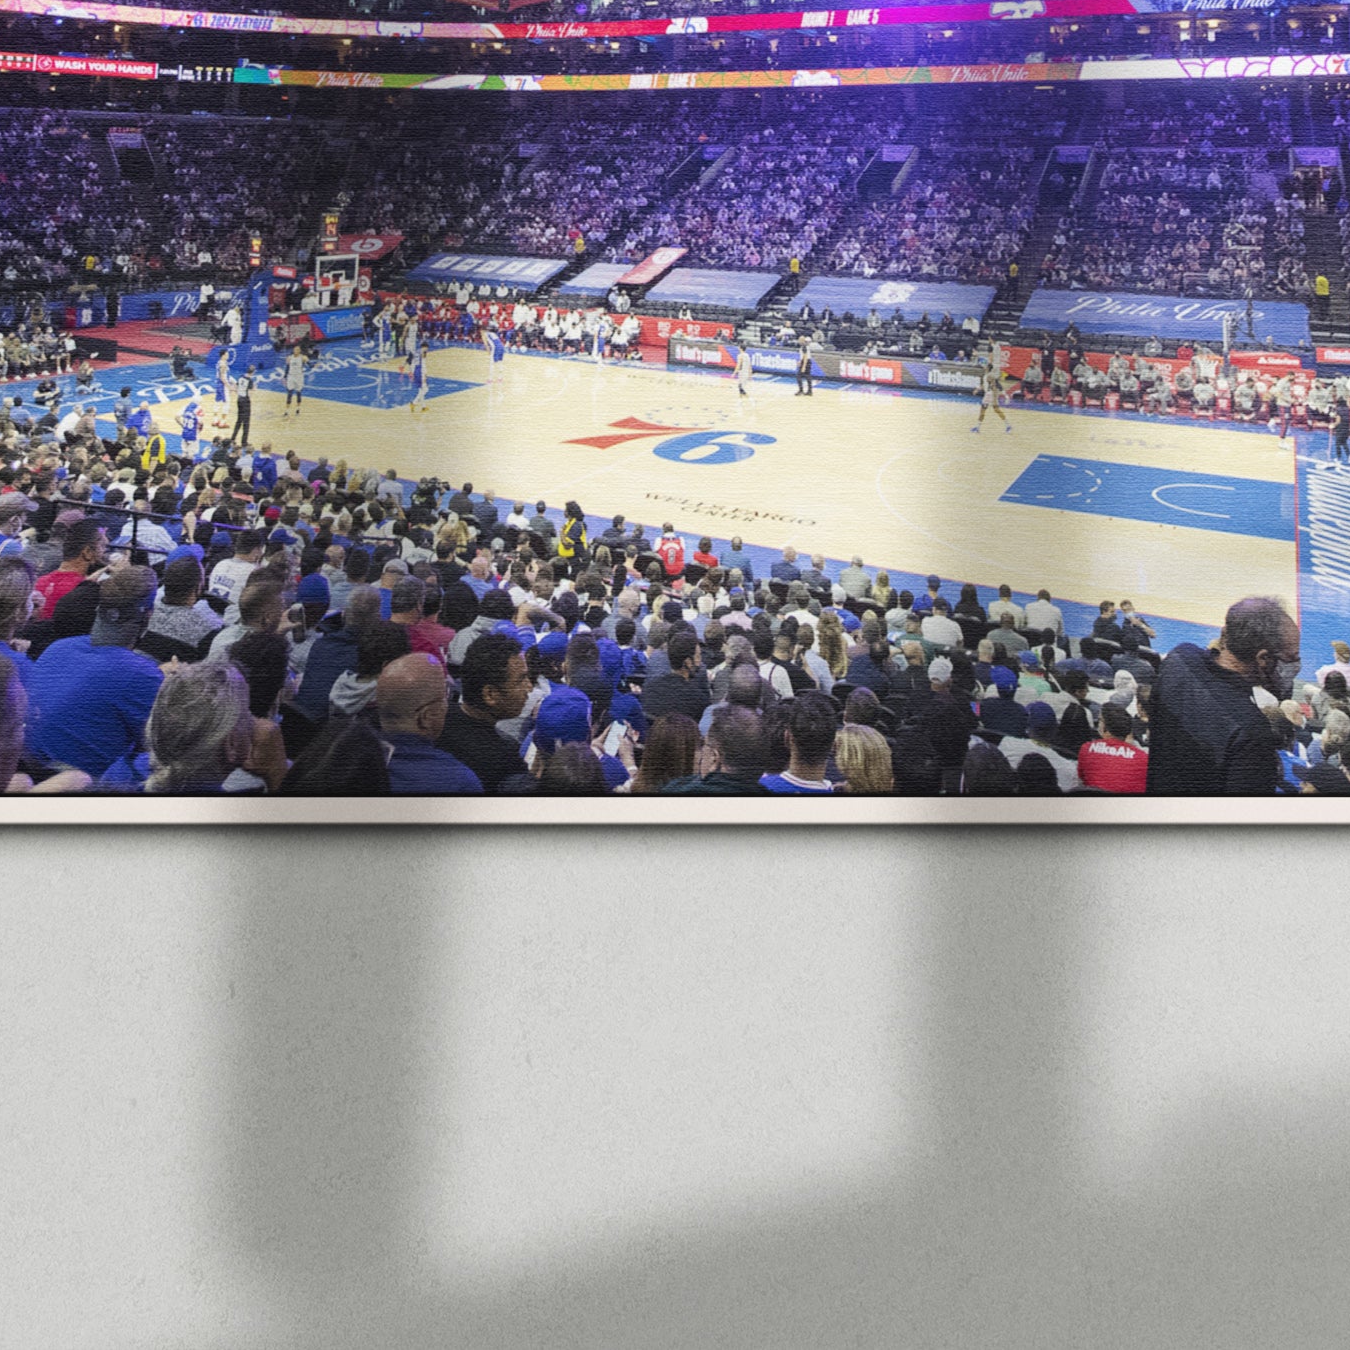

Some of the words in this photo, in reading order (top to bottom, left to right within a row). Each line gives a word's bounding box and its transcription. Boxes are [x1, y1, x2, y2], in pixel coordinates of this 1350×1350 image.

[801, 11, 828, 28] ROUND
[846, 10, 869, 25] GAME
[870, 8, 880, 25] 5
[54, 59, 86, 71] WASH
[88, 62, 117, 73] YOUR
[118, 64, 153, 75] HANDS
[1065, 295, 1167, 317] Phila
[1173, 302, 1265, 322] Une
[558, 415, 778, 465] 76
[645, 491, 728, 512] WELLS
[730, 507, 817, 526] FARGO
